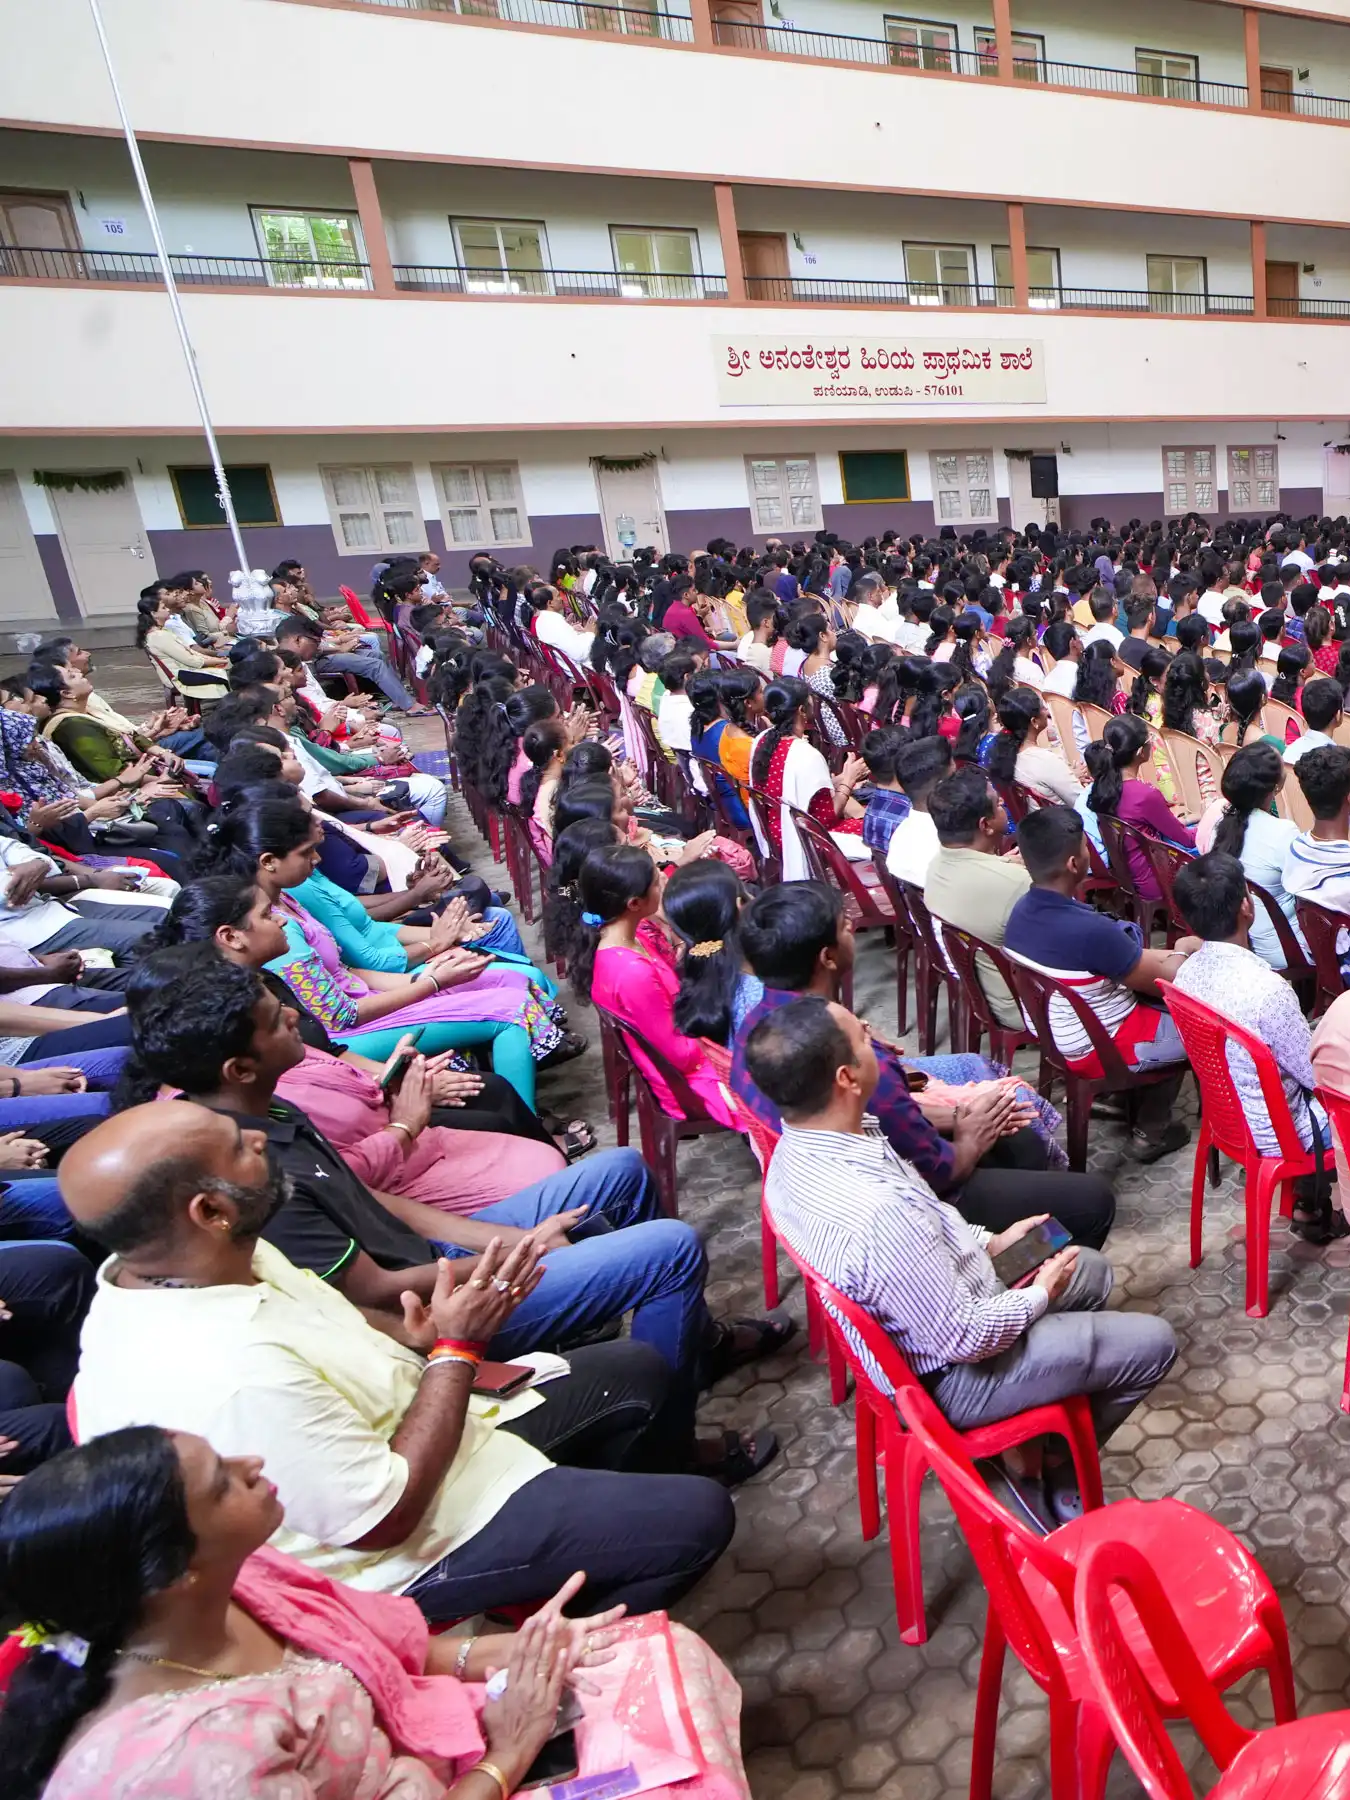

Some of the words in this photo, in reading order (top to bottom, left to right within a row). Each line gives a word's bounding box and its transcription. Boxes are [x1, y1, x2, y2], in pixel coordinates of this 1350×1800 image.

[104, 224, 123, 234] 105
[804, 256, 817, 265] 106
[727, 346, 752, 377] ಶ್ರೀ
[759, 344, 851, 379] ಅನಂತೇಶ್ವರ
[860, 346, 915, 370] ಹಿರಿಯ
[922, 346, 992, 380] ಪ್ರಾಥಮಿಕ
[1000, 347, 1033, 370] ಶಾಲೆ
[875, 385, 914, 397] ಉಡುಪಿ
[924, 385, 964, 396] 576101
